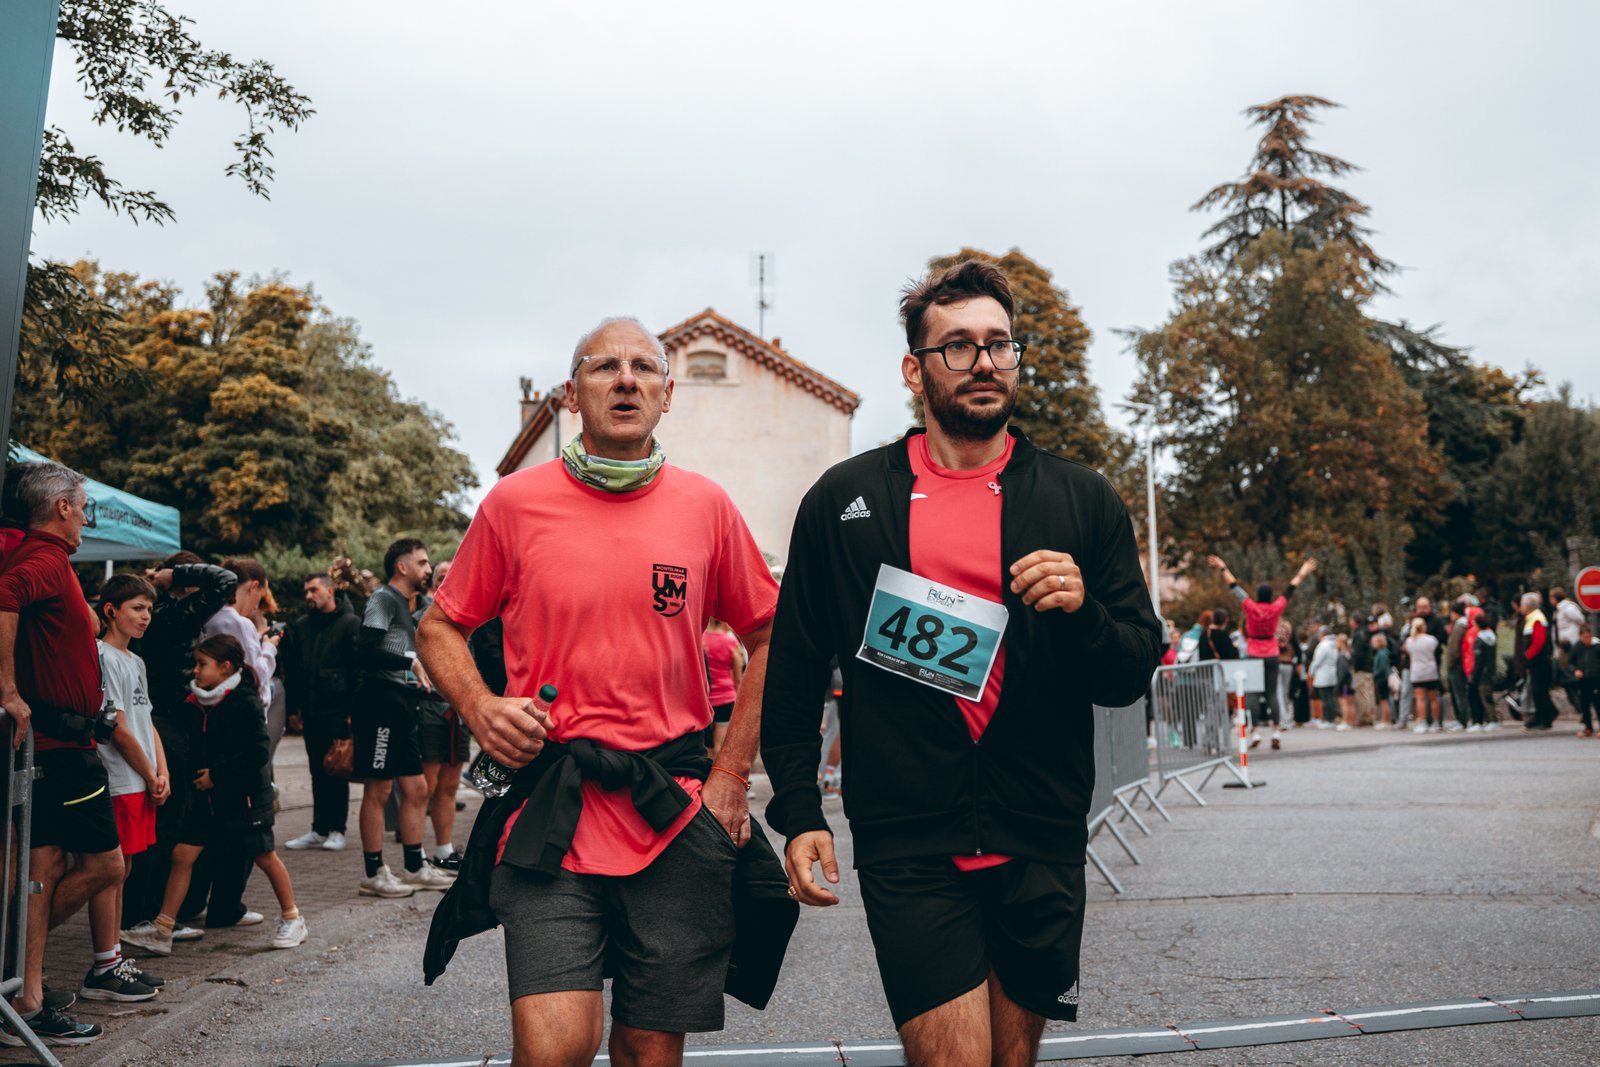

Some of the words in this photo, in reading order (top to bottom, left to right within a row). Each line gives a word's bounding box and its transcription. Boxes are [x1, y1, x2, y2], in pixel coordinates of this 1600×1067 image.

[840, 509, 871, 521] adidas
[926, 588, 956, 604] RUN
[878, 606, 978, 675] 482
[372, 726, 390, 770] SHARKS
[488, 762, 507, 781] VALS
